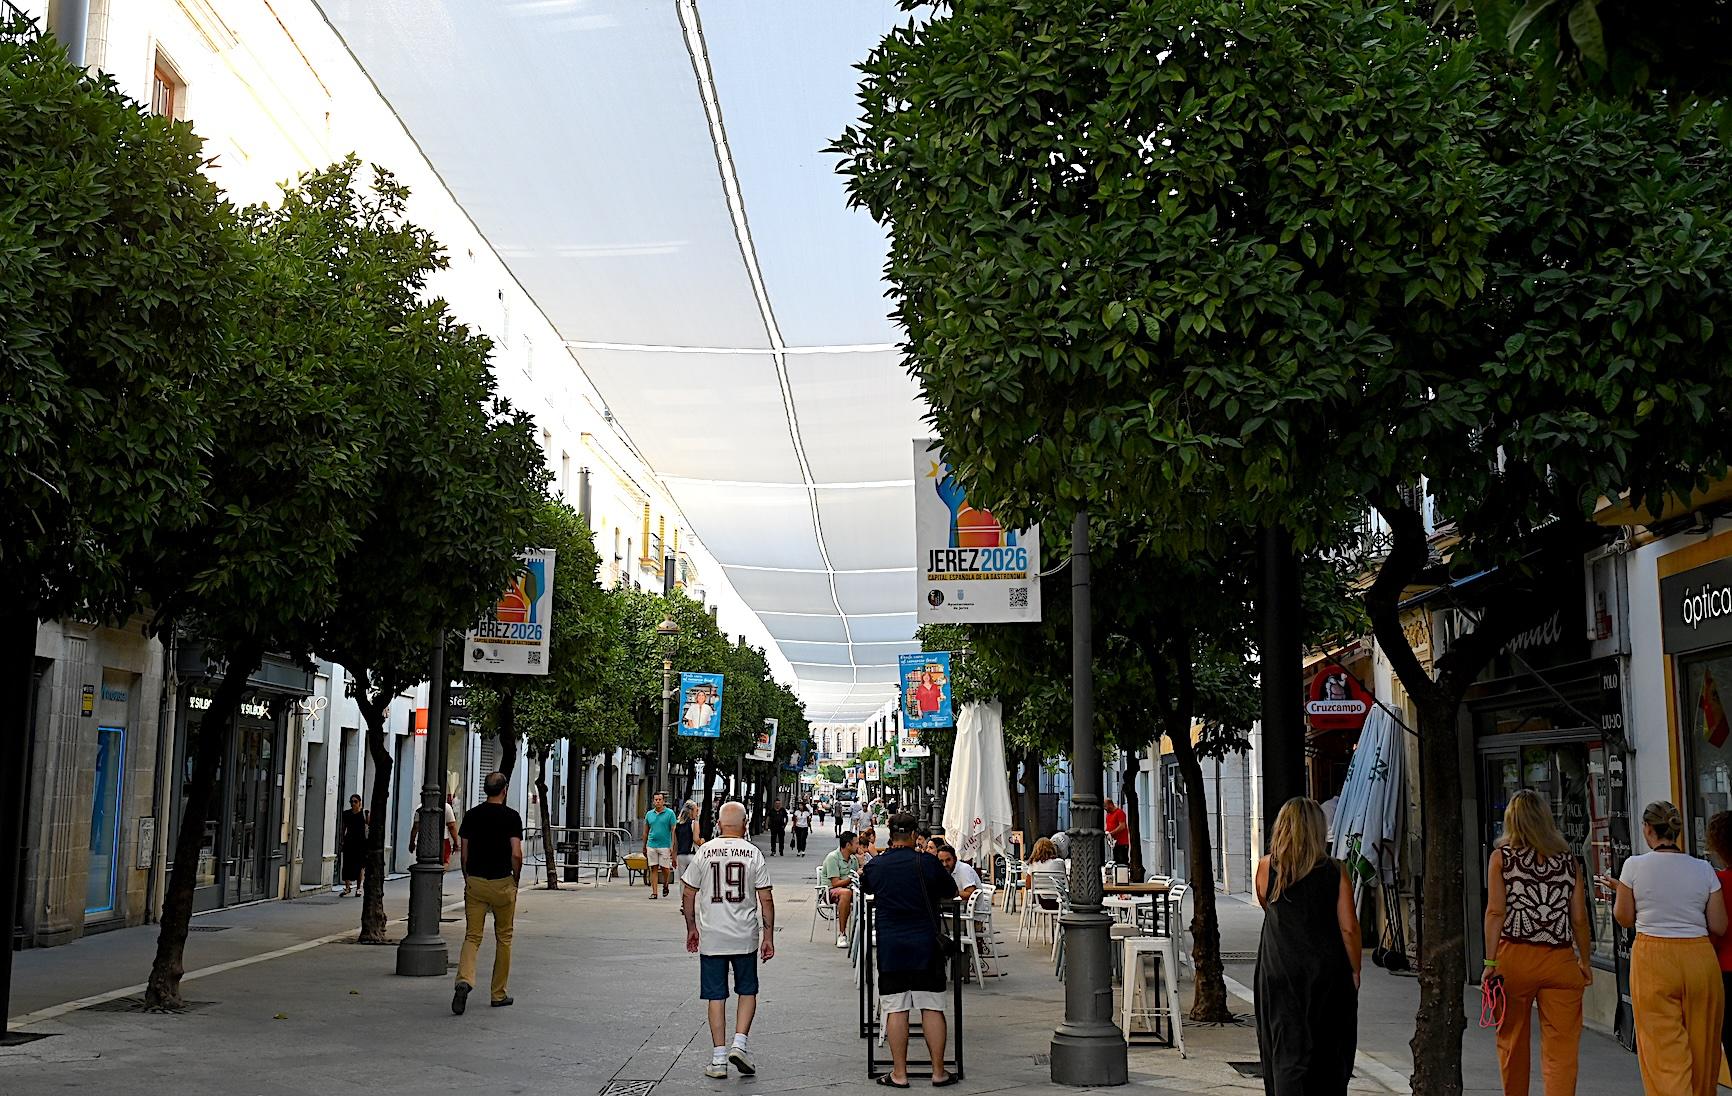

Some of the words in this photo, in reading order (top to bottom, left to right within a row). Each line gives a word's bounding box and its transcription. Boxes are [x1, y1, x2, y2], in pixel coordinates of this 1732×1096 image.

[928, 573, 947, 581] CAPITAL
[1311, 703, 1362, 712] Cruzcampo
[711, 861, 746, 904] 19
